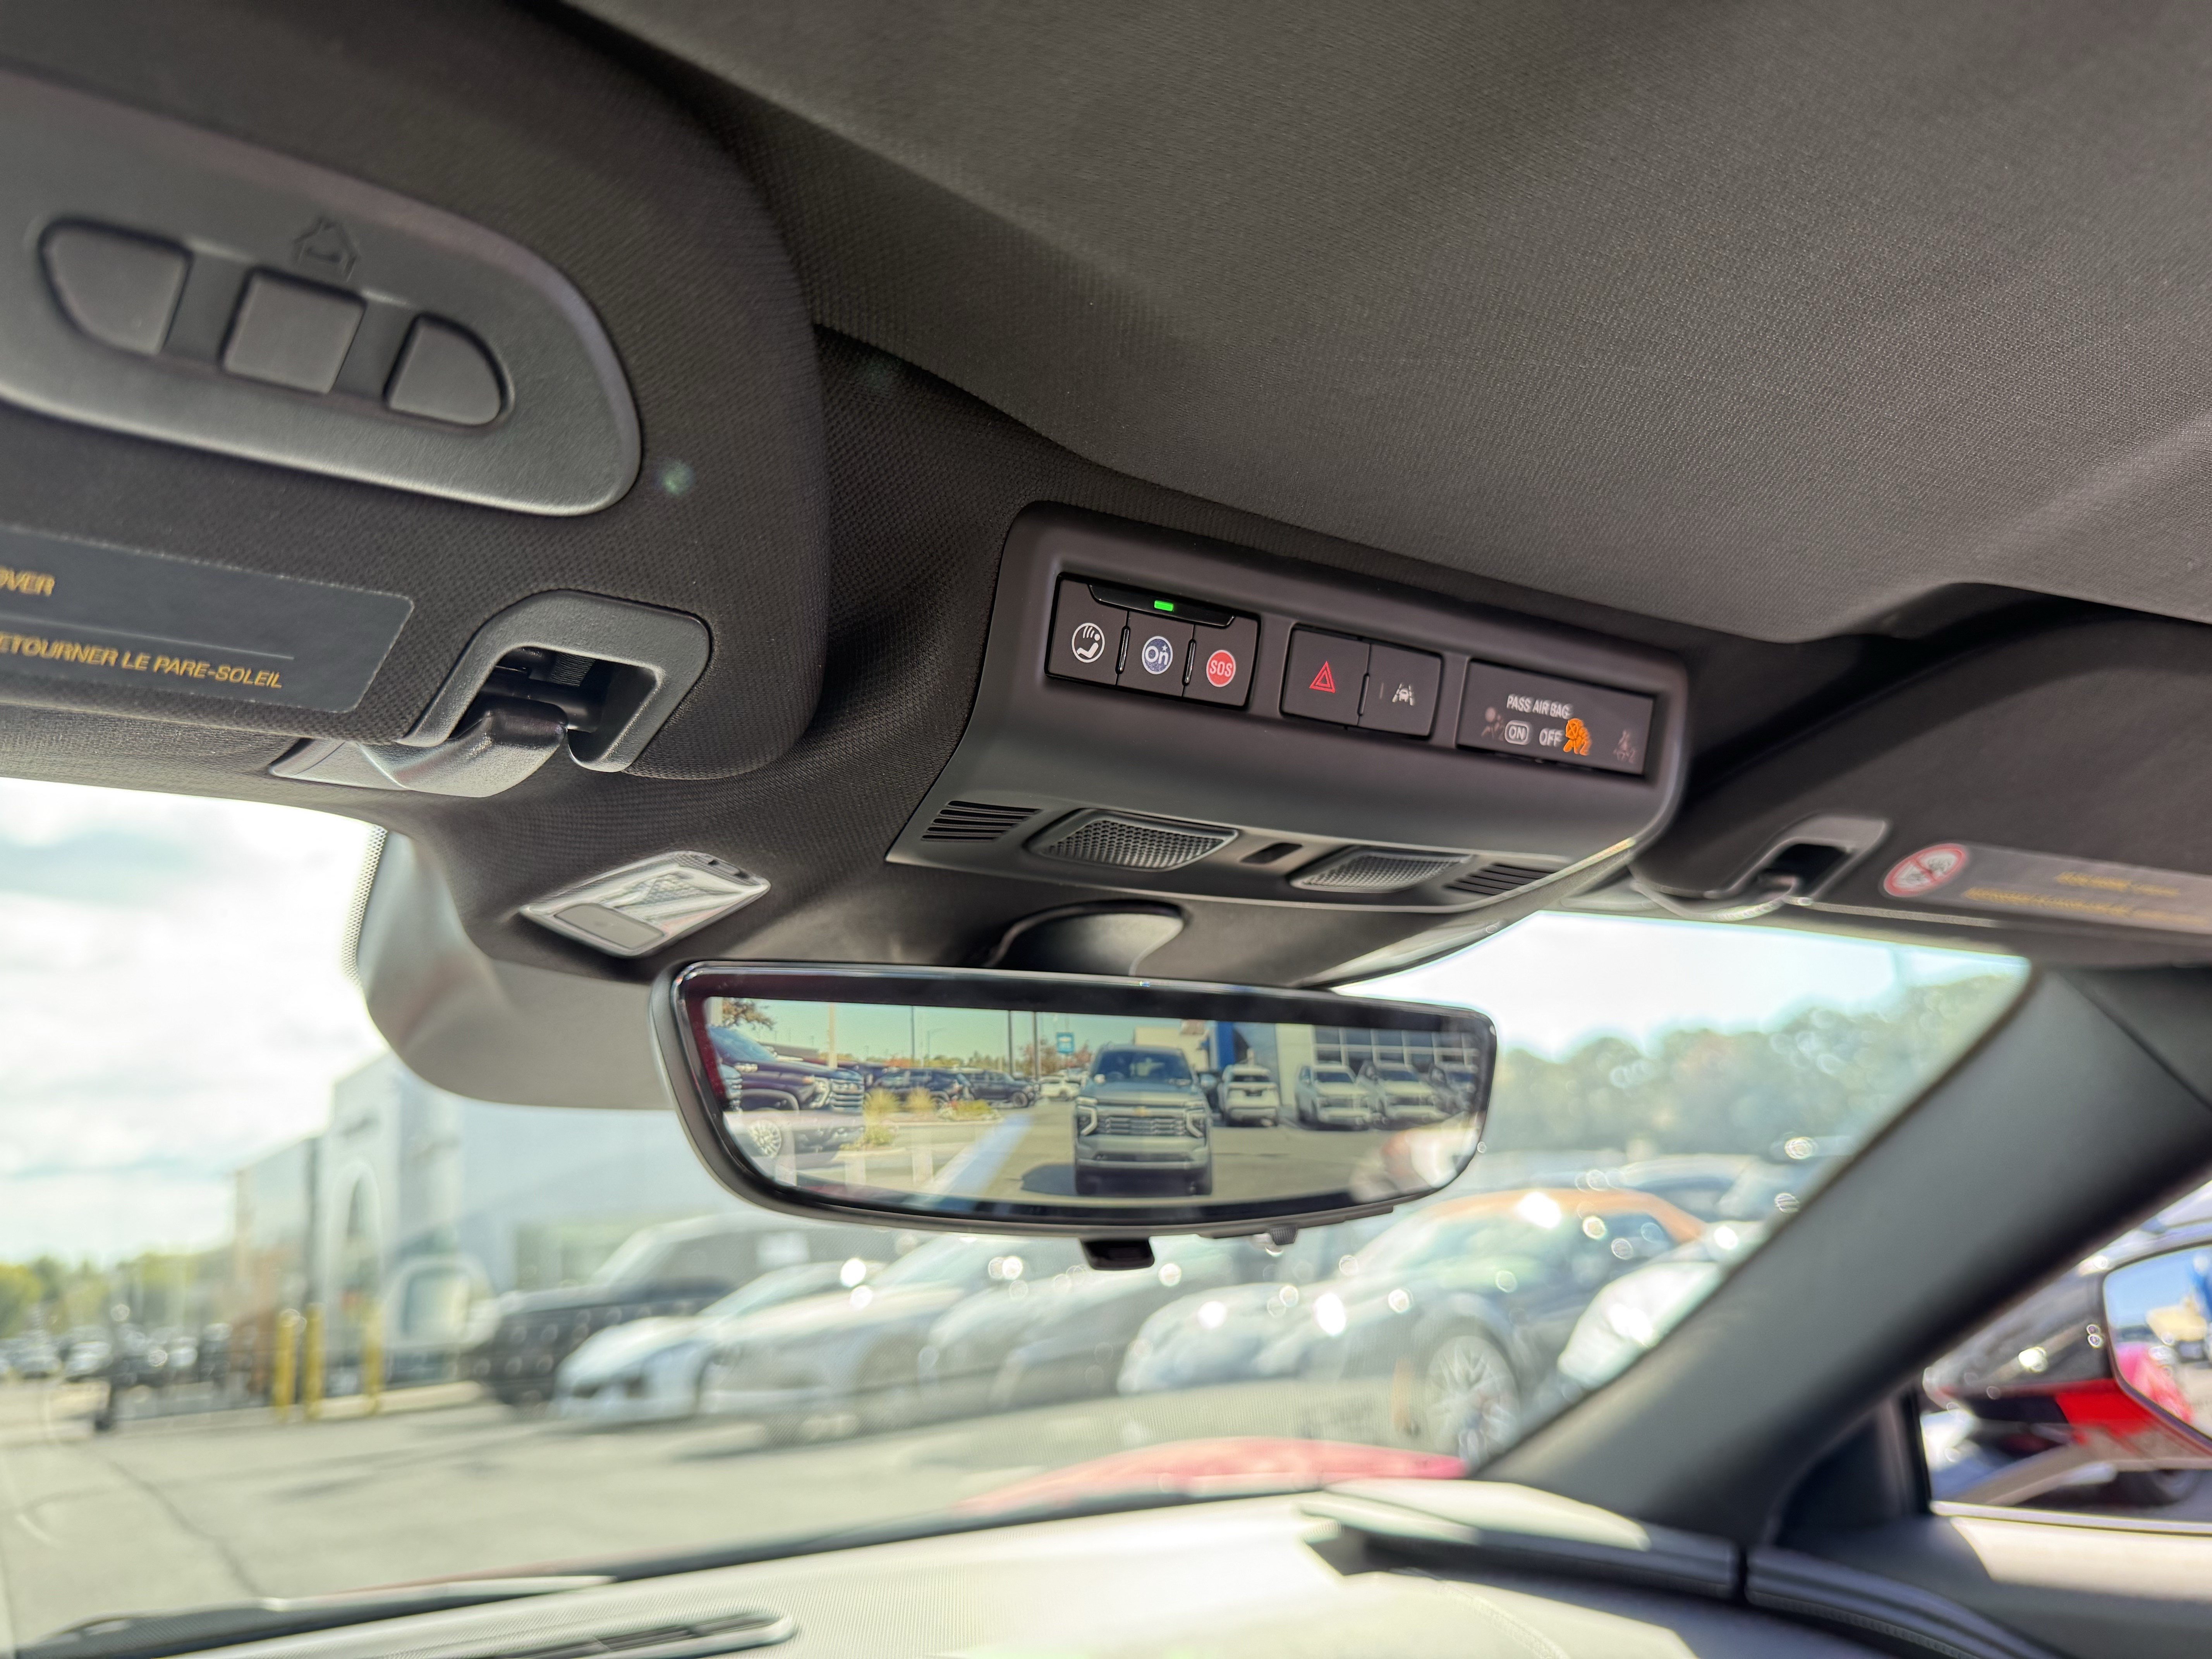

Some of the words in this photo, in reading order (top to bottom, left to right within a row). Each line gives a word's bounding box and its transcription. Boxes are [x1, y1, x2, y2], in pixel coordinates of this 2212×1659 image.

[1145, 646, 1169, 665] On
[121, 651, 151, 671] LE
[153, 655, 282, 689] PARE-SOLEIL
[1209, 659, 1233, 677] SOS
[1506, 694, 1534, 713] PASS
[1532, 699, 1552, 716] AIR
[1550, 701, 1573, 720] BAG
[1509, 725, 1527, 740] ON
[1539, 728, 1565, 747] OFF
